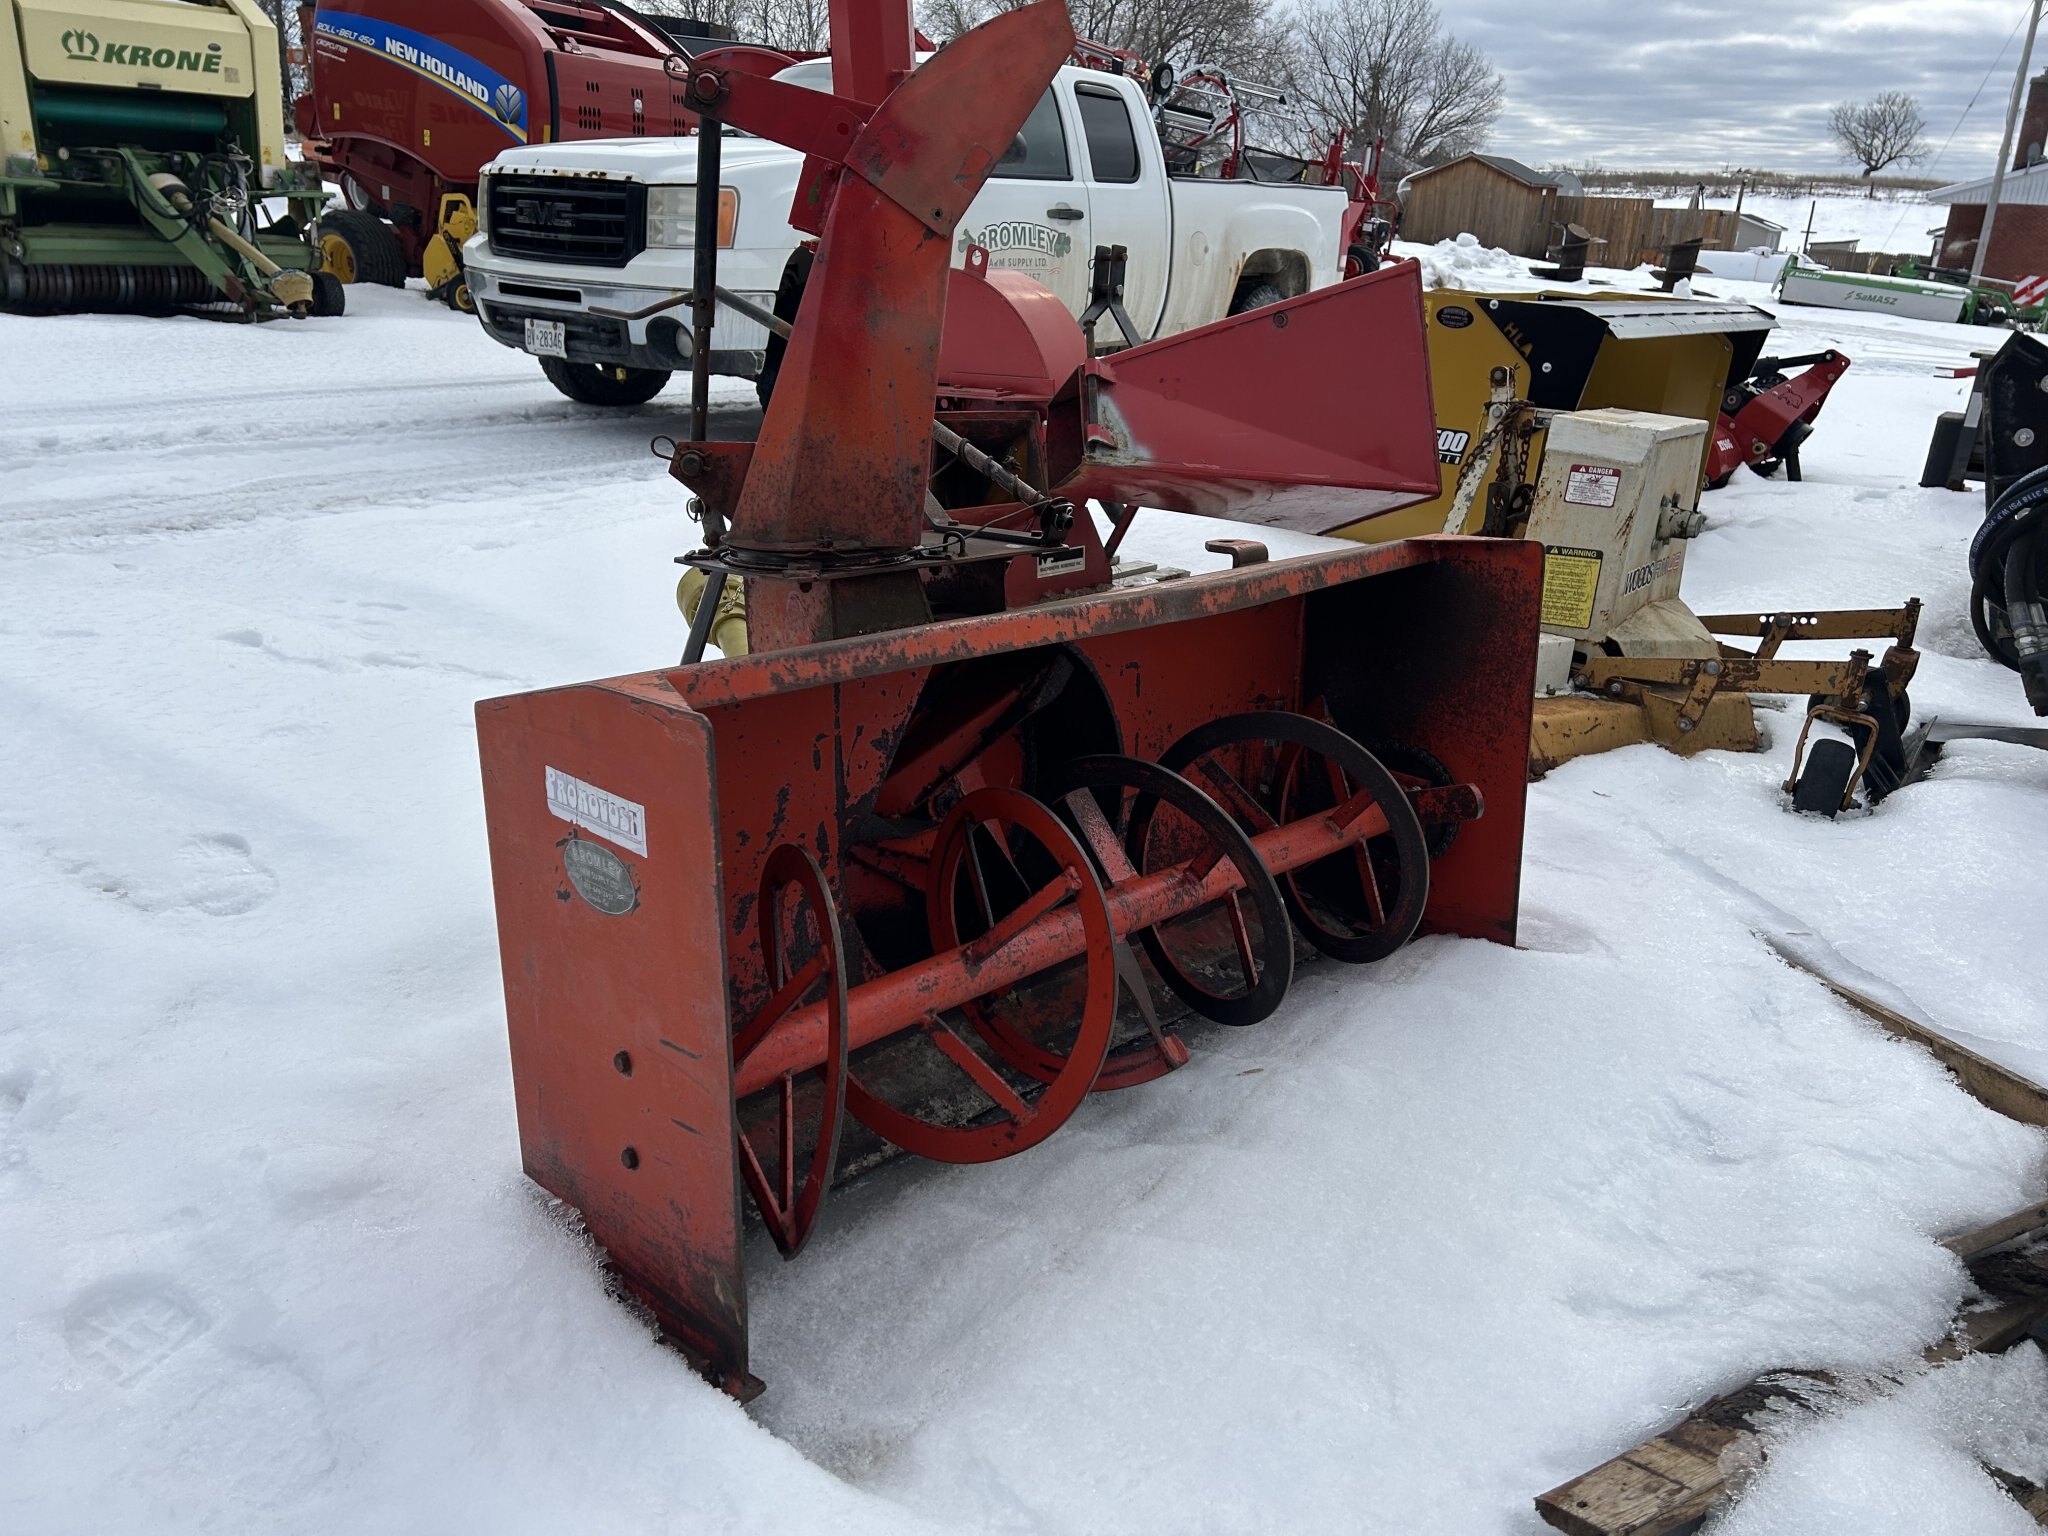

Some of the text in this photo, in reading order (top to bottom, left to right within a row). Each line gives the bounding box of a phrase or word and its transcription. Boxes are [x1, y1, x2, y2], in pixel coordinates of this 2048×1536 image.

[358, 34, 376, 46] 450
[102, 42, 222, 73] KRONE
[385, 36, 489, 103] NEW HOLLAND
[515, 199, 575, 228] GMC
[976, 222, 1058, 257] BROMLEY
[988, 257, 1006, 267] ARM
[1007, 257, 1033, 267] SUPPLY
[1853, 291, 1898, 306] SaMASZ
[538, 329, 563, 350] 28346
[1503, 321, 1535, 359] HLA
[1588, 466, 1614, 476] DANGER
[1561, 547, 1597, 558] WARNING
[1623, 561, 1655, 597] WOODS
[546, 771, 640, 837] PRONOVOST
[571, 846, 623, 880] BROMLEY
